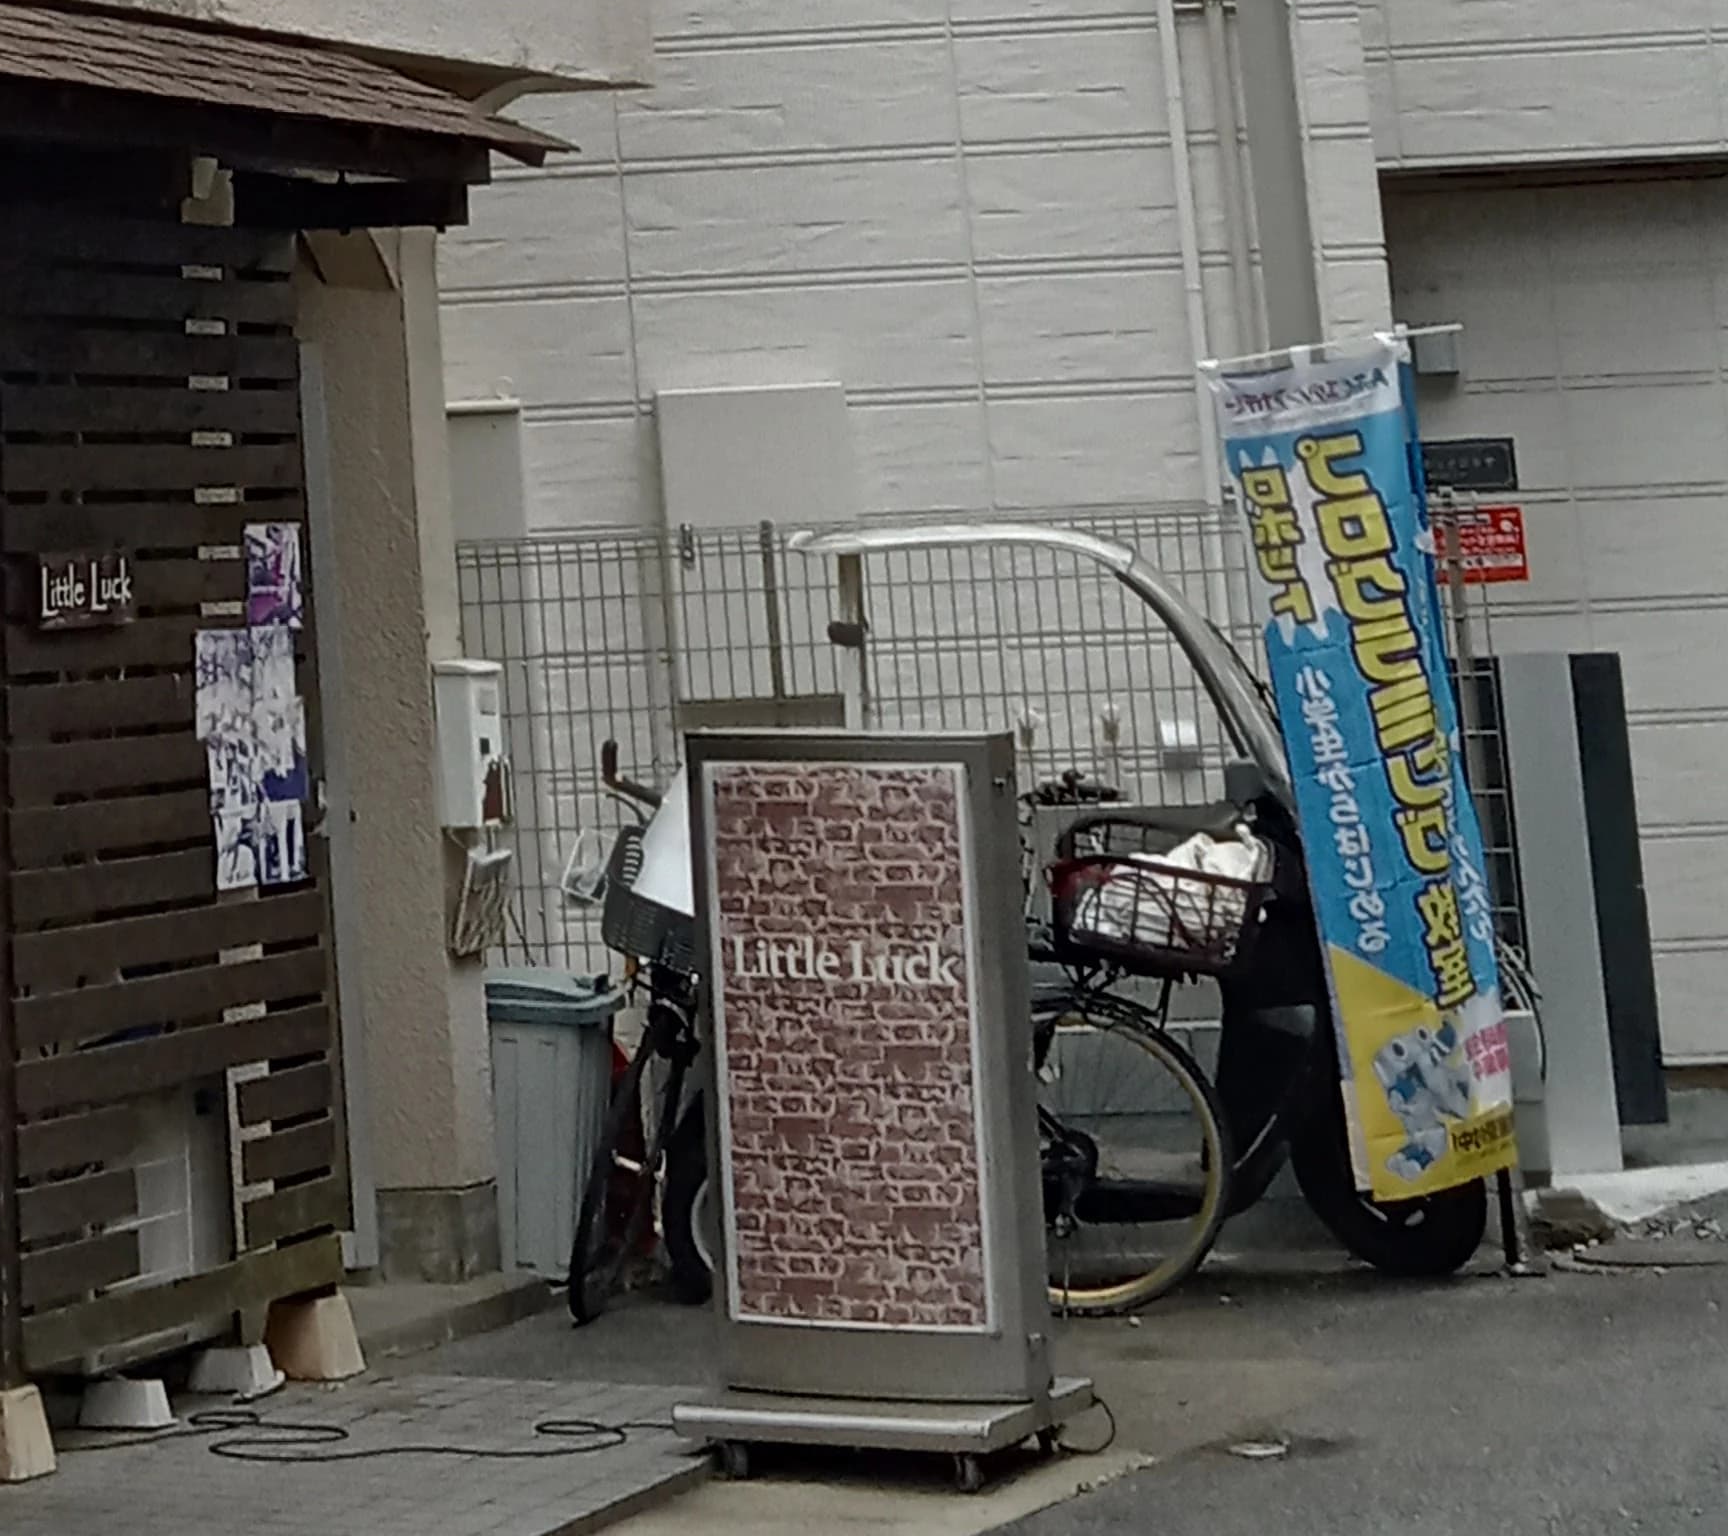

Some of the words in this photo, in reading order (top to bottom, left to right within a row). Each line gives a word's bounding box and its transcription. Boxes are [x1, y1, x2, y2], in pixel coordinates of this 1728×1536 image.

[41, 563, 85, 616] Little
[90, 557, 132, 611] Luck
[731, 935, 841, 982] Little
[850, 942, 961, 986] Luck
